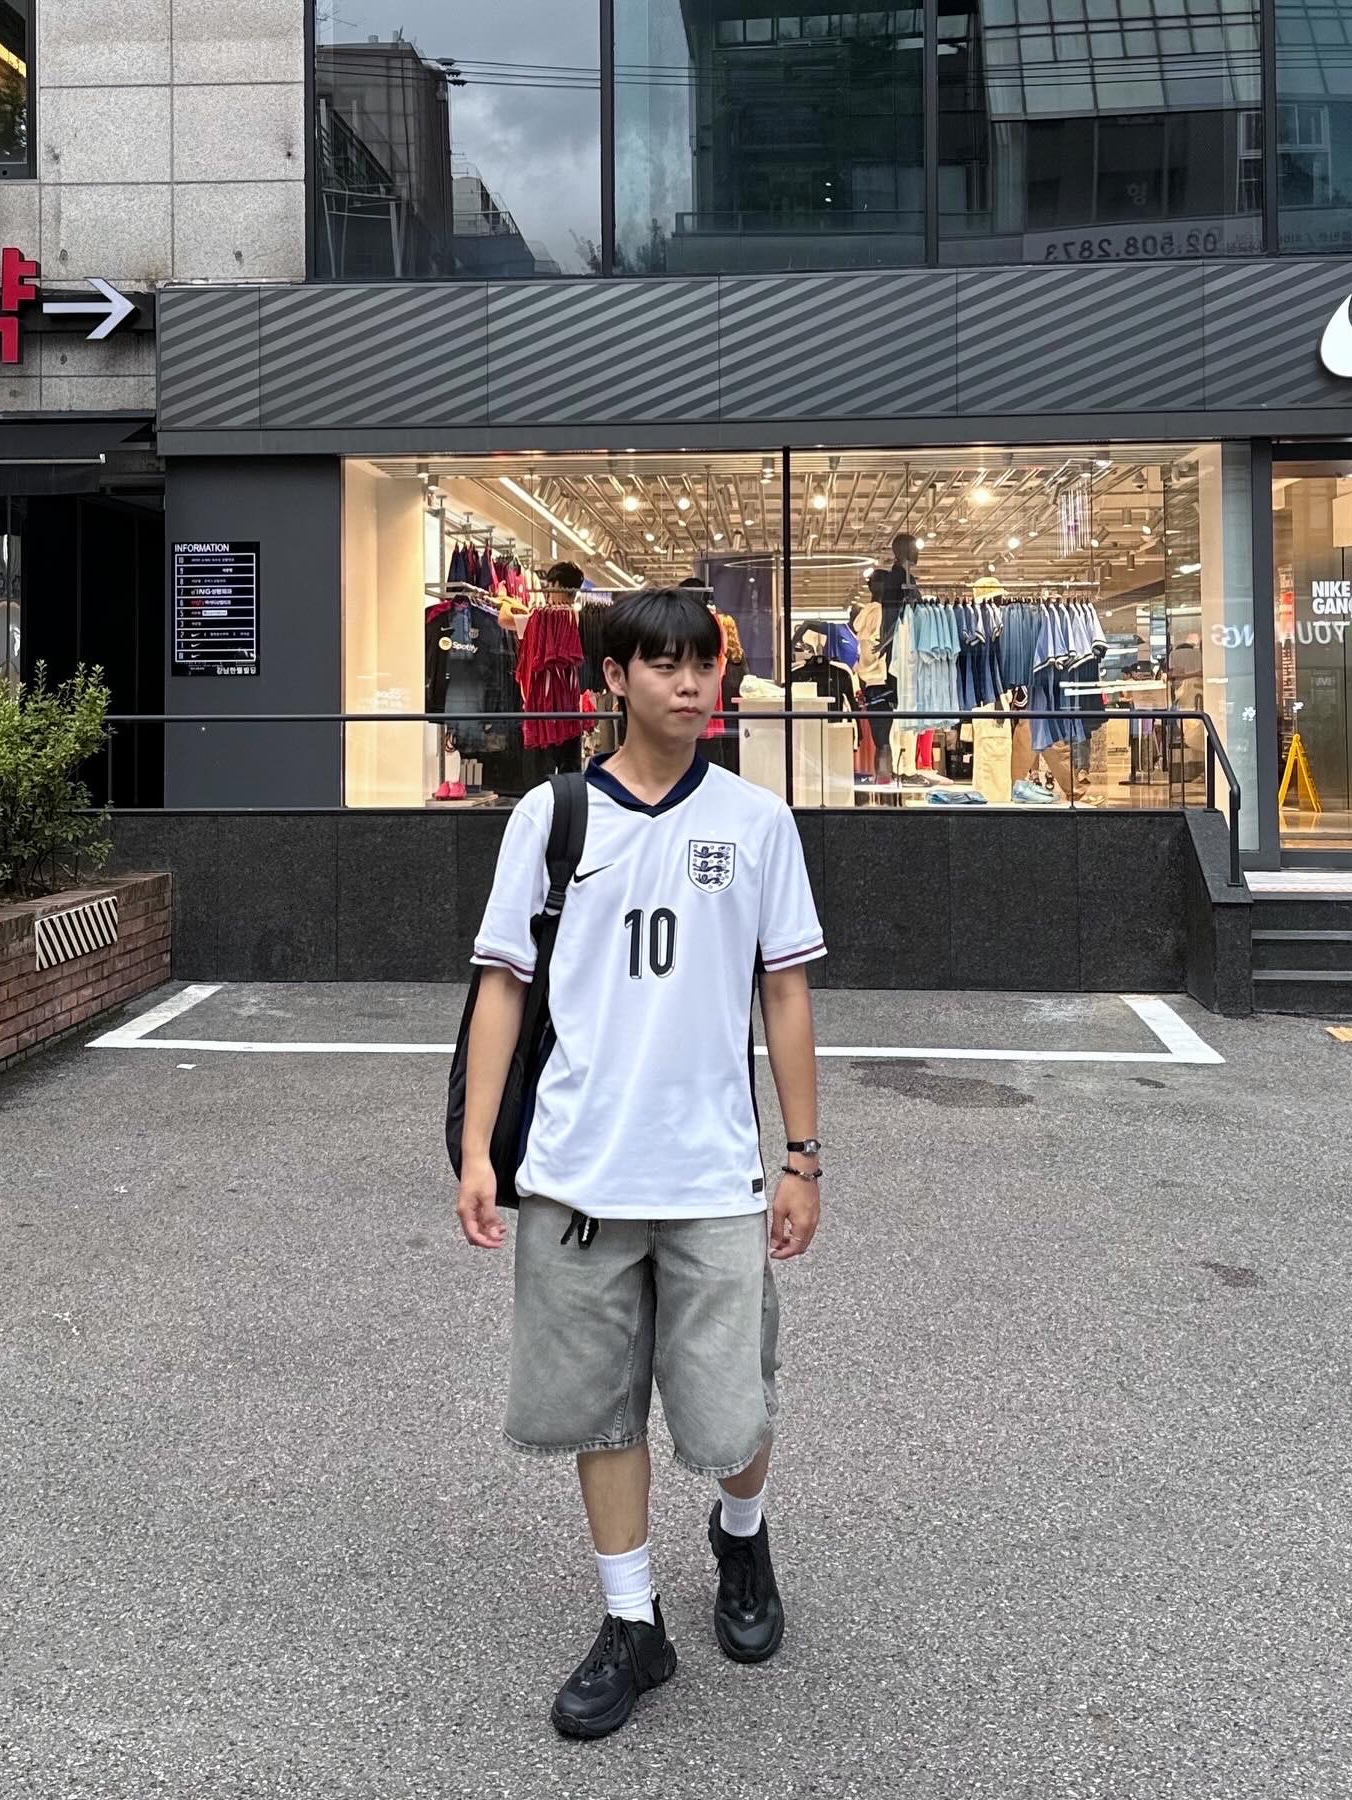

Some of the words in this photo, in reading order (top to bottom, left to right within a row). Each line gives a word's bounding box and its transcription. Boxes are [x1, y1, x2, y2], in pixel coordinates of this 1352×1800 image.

[174, 543, 229, 553] INFORMATION
[1311, 580, 1351, 597] NIKE
[452, 641, 478, 653] Spotify
[624, 907, 678, 980] 10
